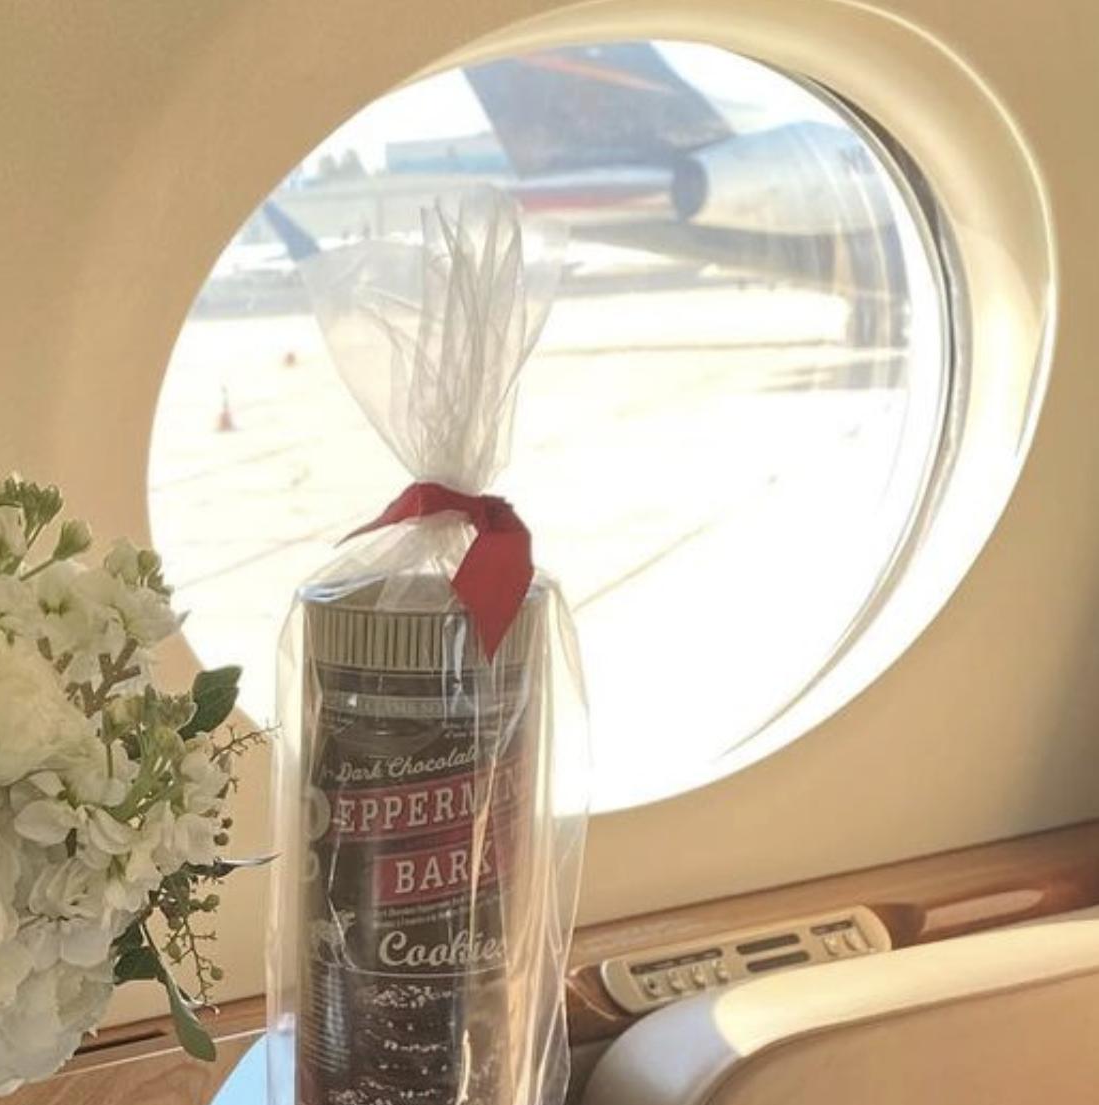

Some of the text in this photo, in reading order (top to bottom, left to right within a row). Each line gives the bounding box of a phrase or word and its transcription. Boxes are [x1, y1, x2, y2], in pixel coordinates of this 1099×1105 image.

[335, 744, 479, 783] Dark Chocolat
[394, 841, 493, 894] BARK
